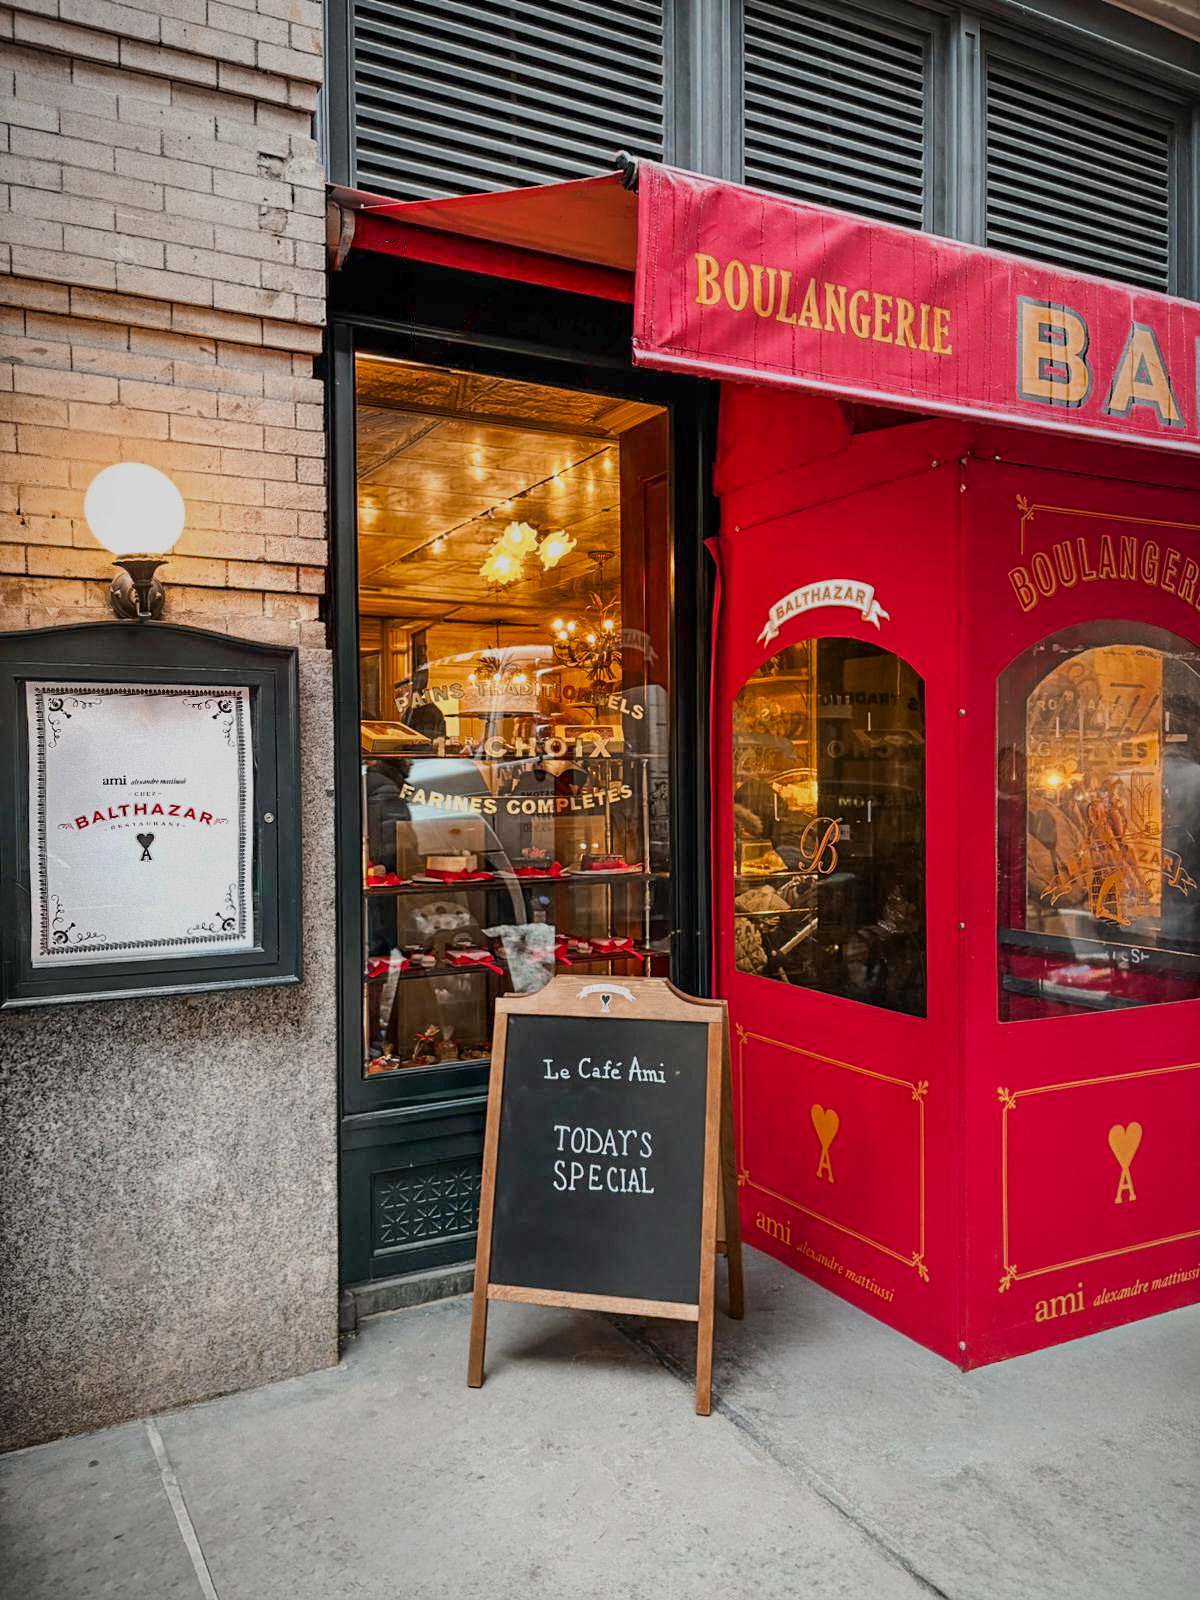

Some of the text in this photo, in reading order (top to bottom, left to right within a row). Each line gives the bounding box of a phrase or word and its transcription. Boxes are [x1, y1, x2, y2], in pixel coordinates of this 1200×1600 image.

[695, 253, 953, 356] BOULANGERIE
[1017, 295, 1200, 430] BA
[1008, 534, 1200, 612] BOULANGER
[775, 585, 866, 619] BALTHAZAR
[395, 683, 465, 712] PAINS
[484, 735, 611, 758] CHOIX
[103, 775, 127, 785] ami
[399, 783, 497, 814] FARINES
[75, 803, 213, 829] BALTHAZAR
[798, 816, 843, 875] B
[542, 1056, 667, 1083] Le Café Ami
[554, 1125, 653, 1158] TODAY'S
[553, 1160, 654, 1194] SPECIAL
[755, 1211, 895, 1302] ami alexandre mattiussi
[1034, 1263, 1200, 1322] ami alexandre mattiussi
